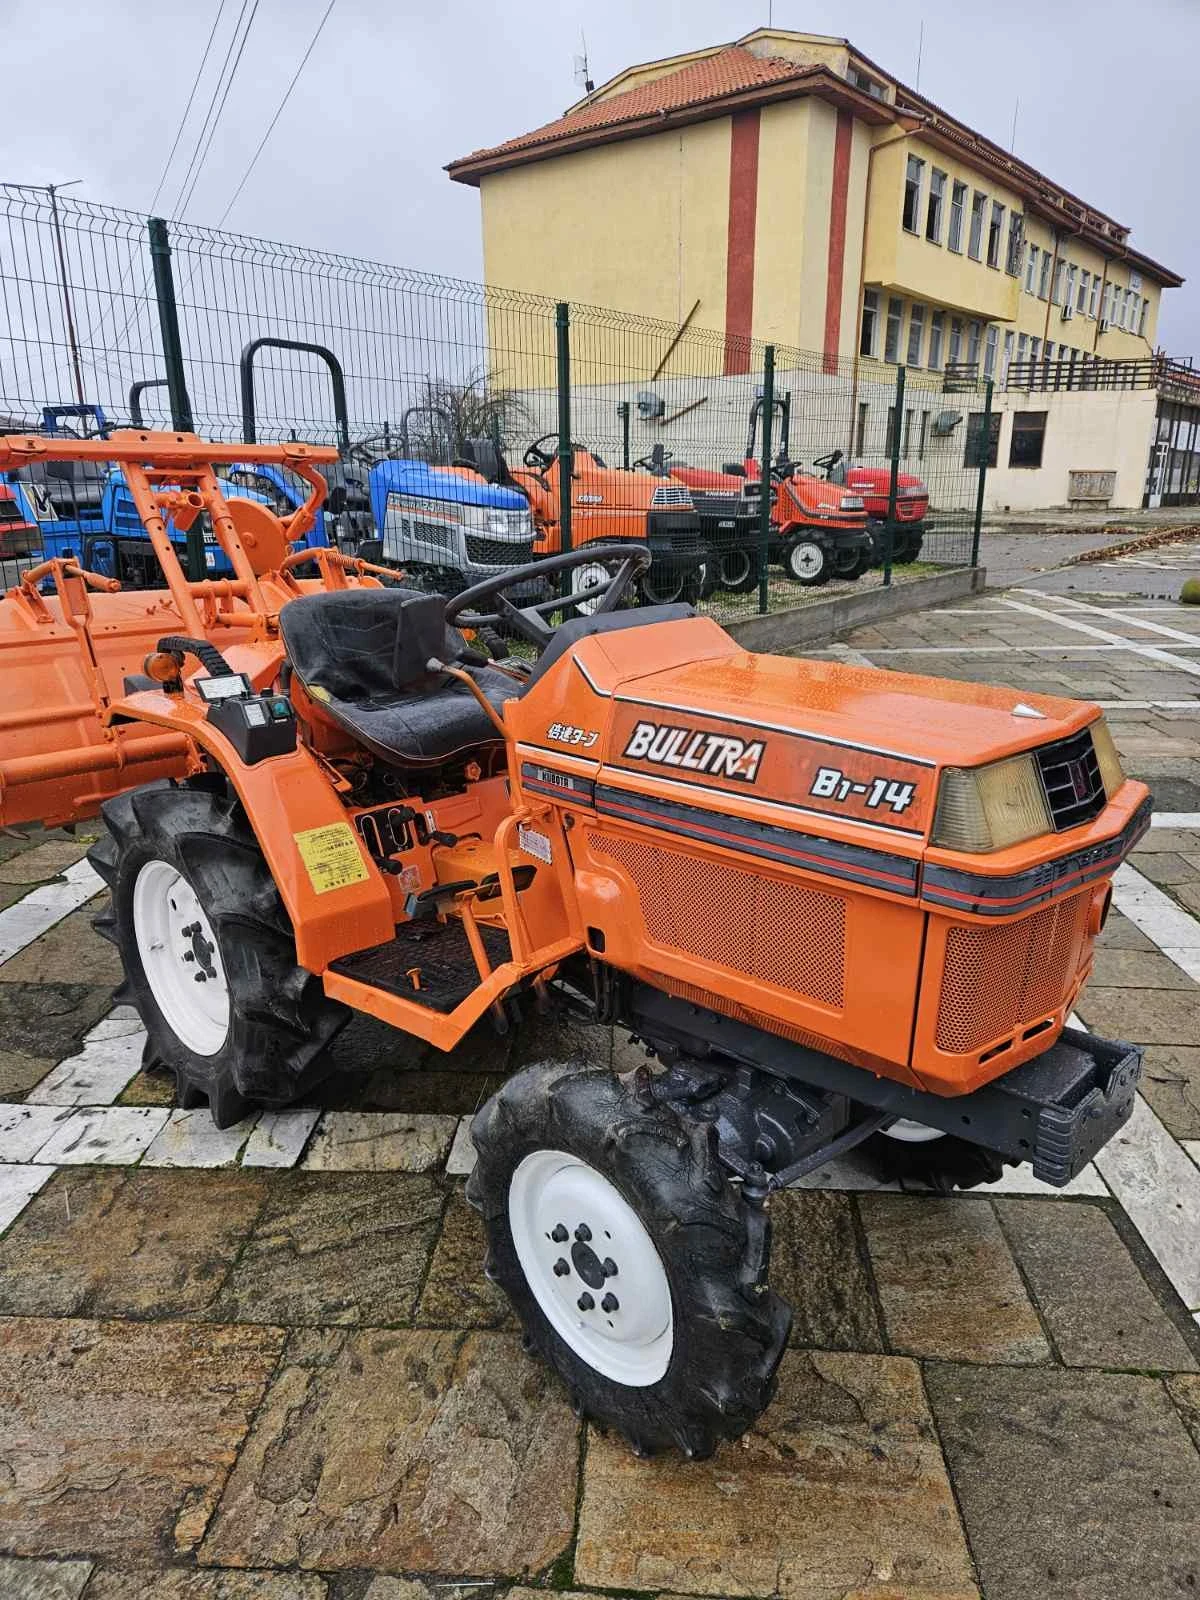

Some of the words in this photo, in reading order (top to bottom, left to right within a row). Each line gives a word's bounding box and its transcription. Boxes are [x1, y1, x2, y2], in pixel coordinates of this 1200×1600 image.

[547, 722, 600, 747] 倍速ターン
[622, 721, 766, 783] BULLTRA
[541, 769, 570, 788] KUBOTA
[810, 767, 916, 812] B1-14
